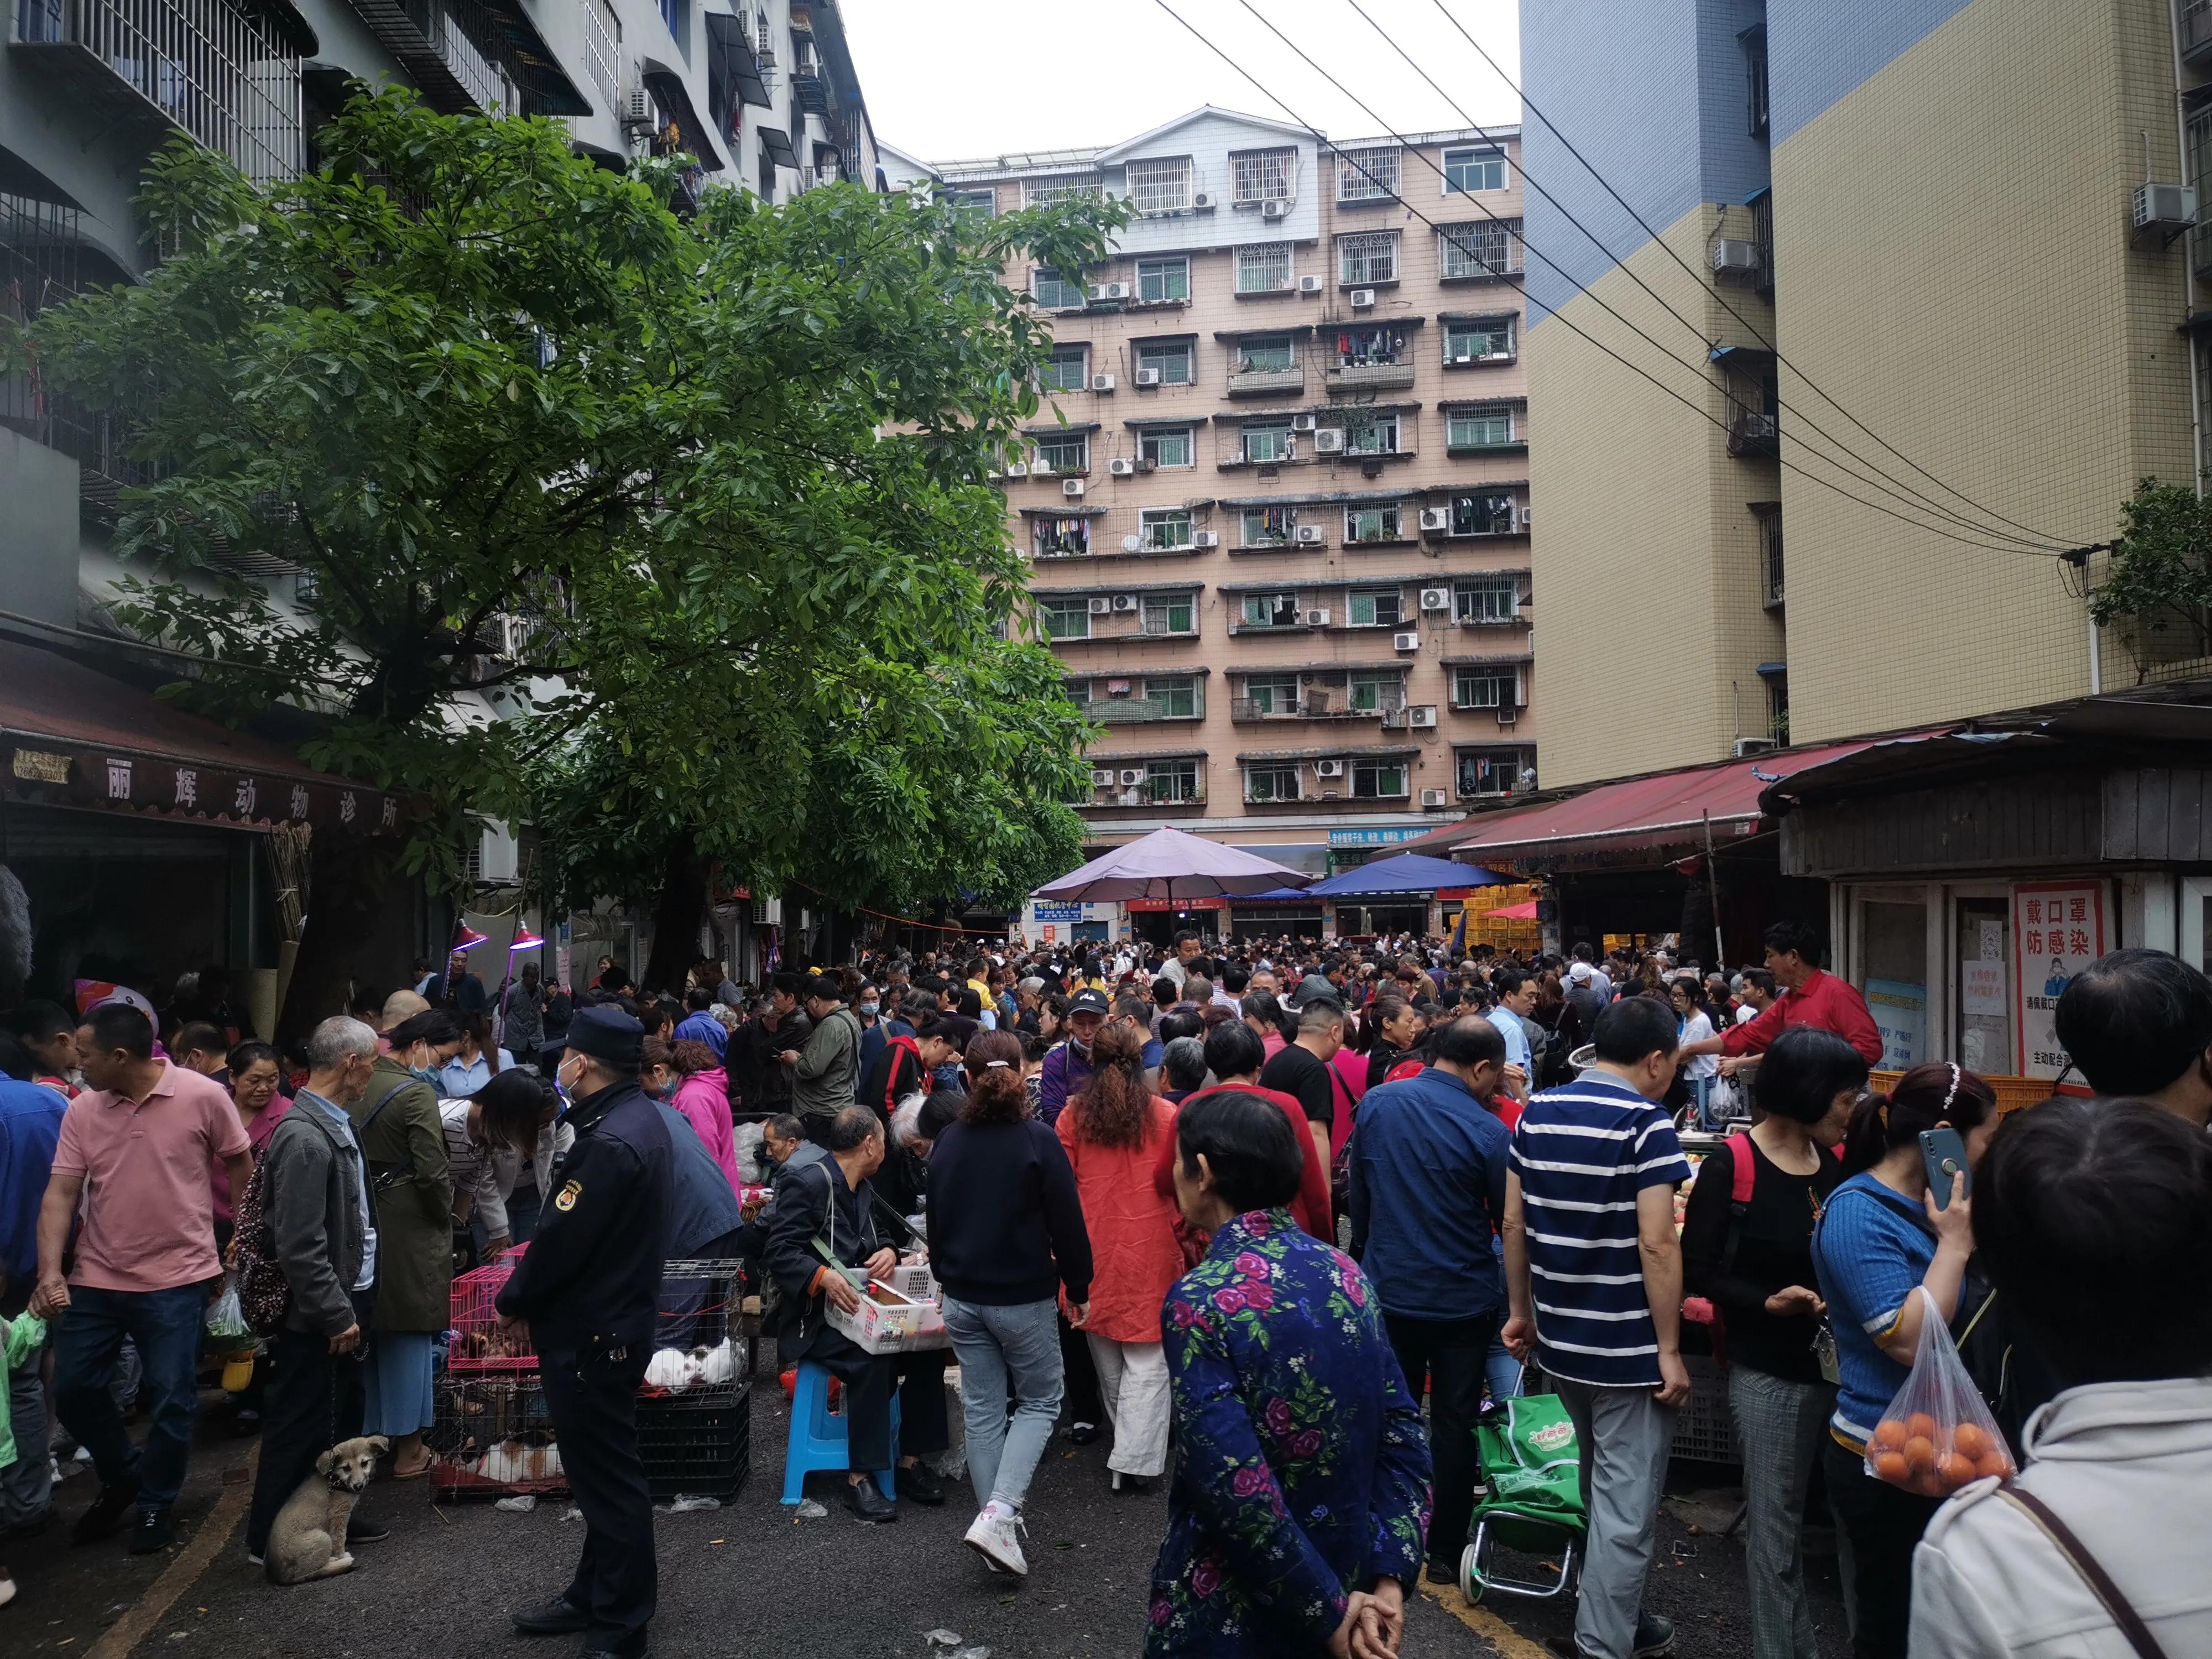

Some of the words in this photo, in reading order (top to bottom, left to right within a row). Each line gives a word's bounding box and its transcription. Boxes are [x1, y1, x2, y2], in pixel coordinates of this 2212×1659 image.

[106, 758, 398, 828] 丽辉动物诊所
[2026, 898, 2087, 925] 戴口罩
[2027, 928, 2089, 956] 防感染
